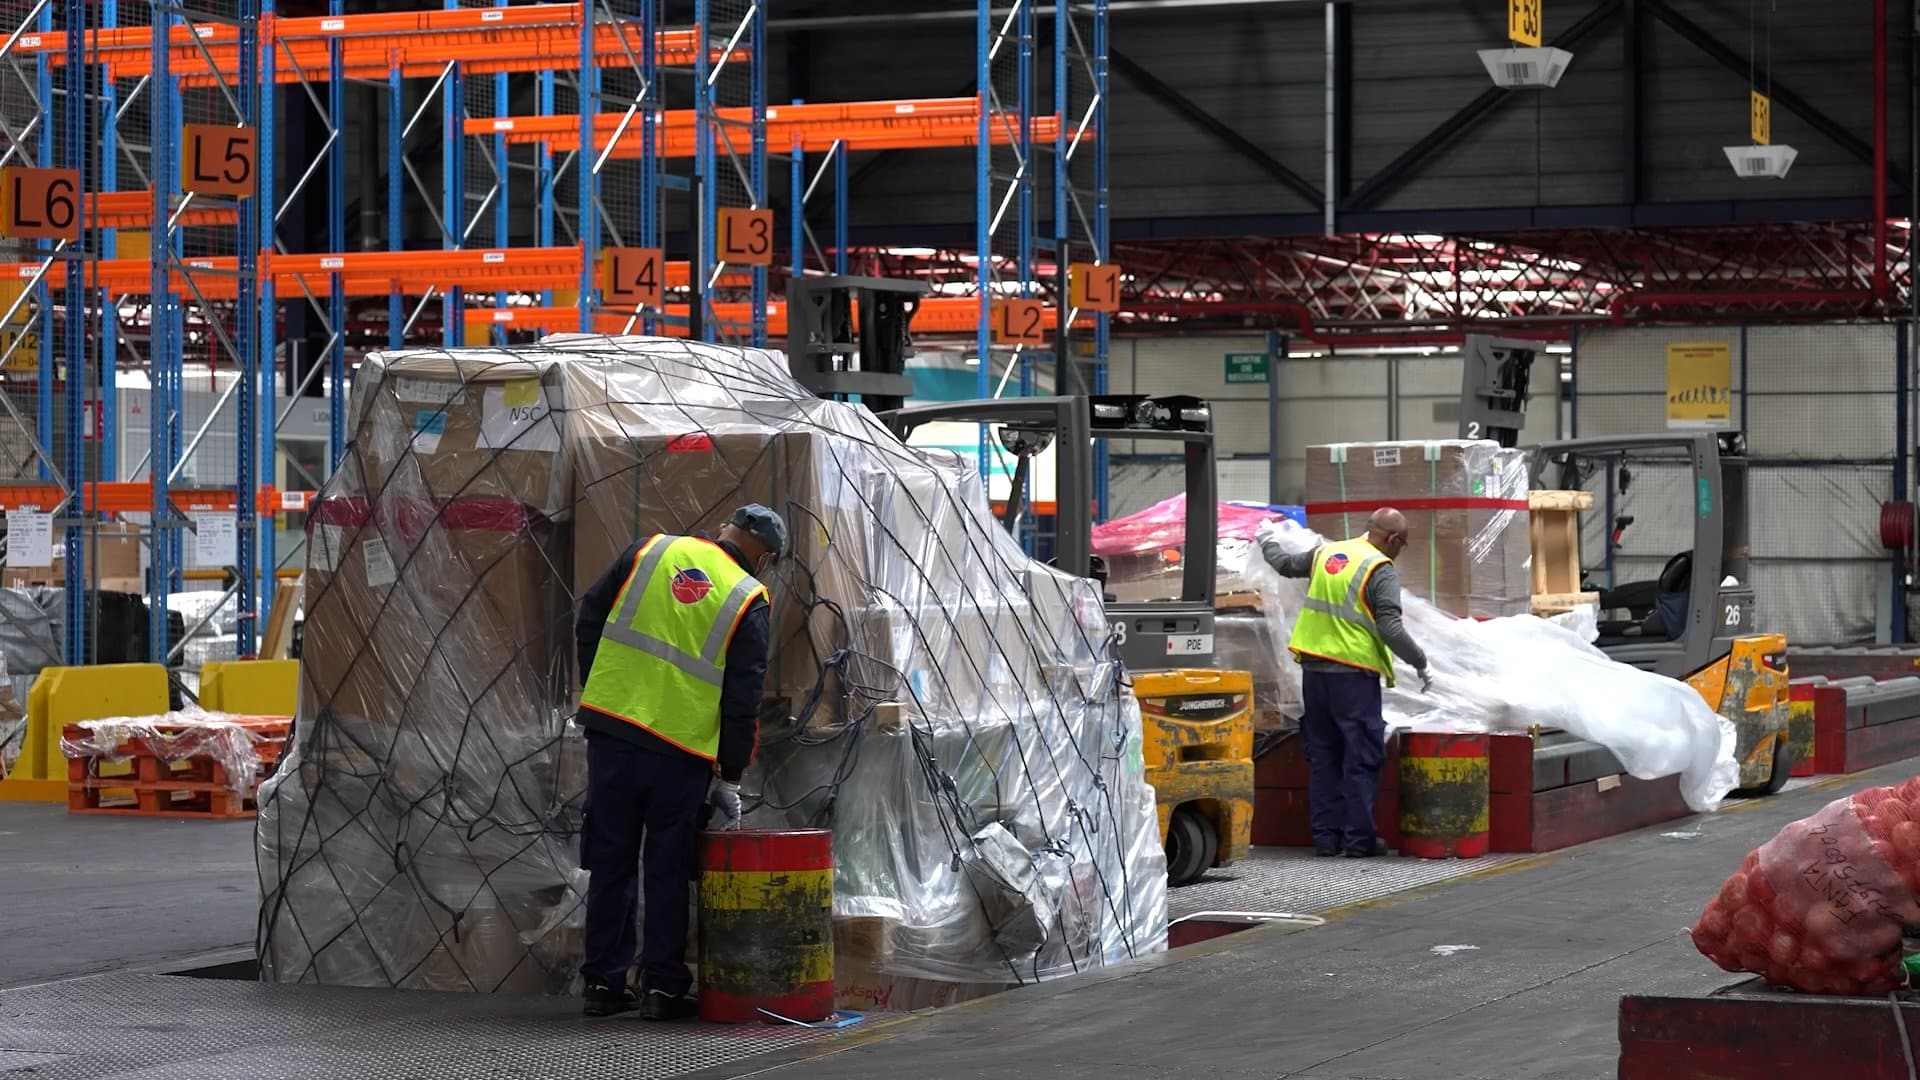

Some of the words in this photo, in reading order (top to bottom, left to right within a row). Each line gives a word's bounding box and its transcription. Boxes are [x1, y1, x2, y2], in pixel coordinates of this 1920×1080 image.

[194, 135, 250, 184] L5
[13, 176, 74, 228] L6
[727, 216, 769, 255] L3
[613, 256, 657, 296] L4
[1085, 271, 1115, 304] L1
[1005, 305, 1040, 338] L2
[509, 406, 541, 422] NSC
[1725, 605, 1740, 626] 26
[1187, 639, 1202, 650] PDE
